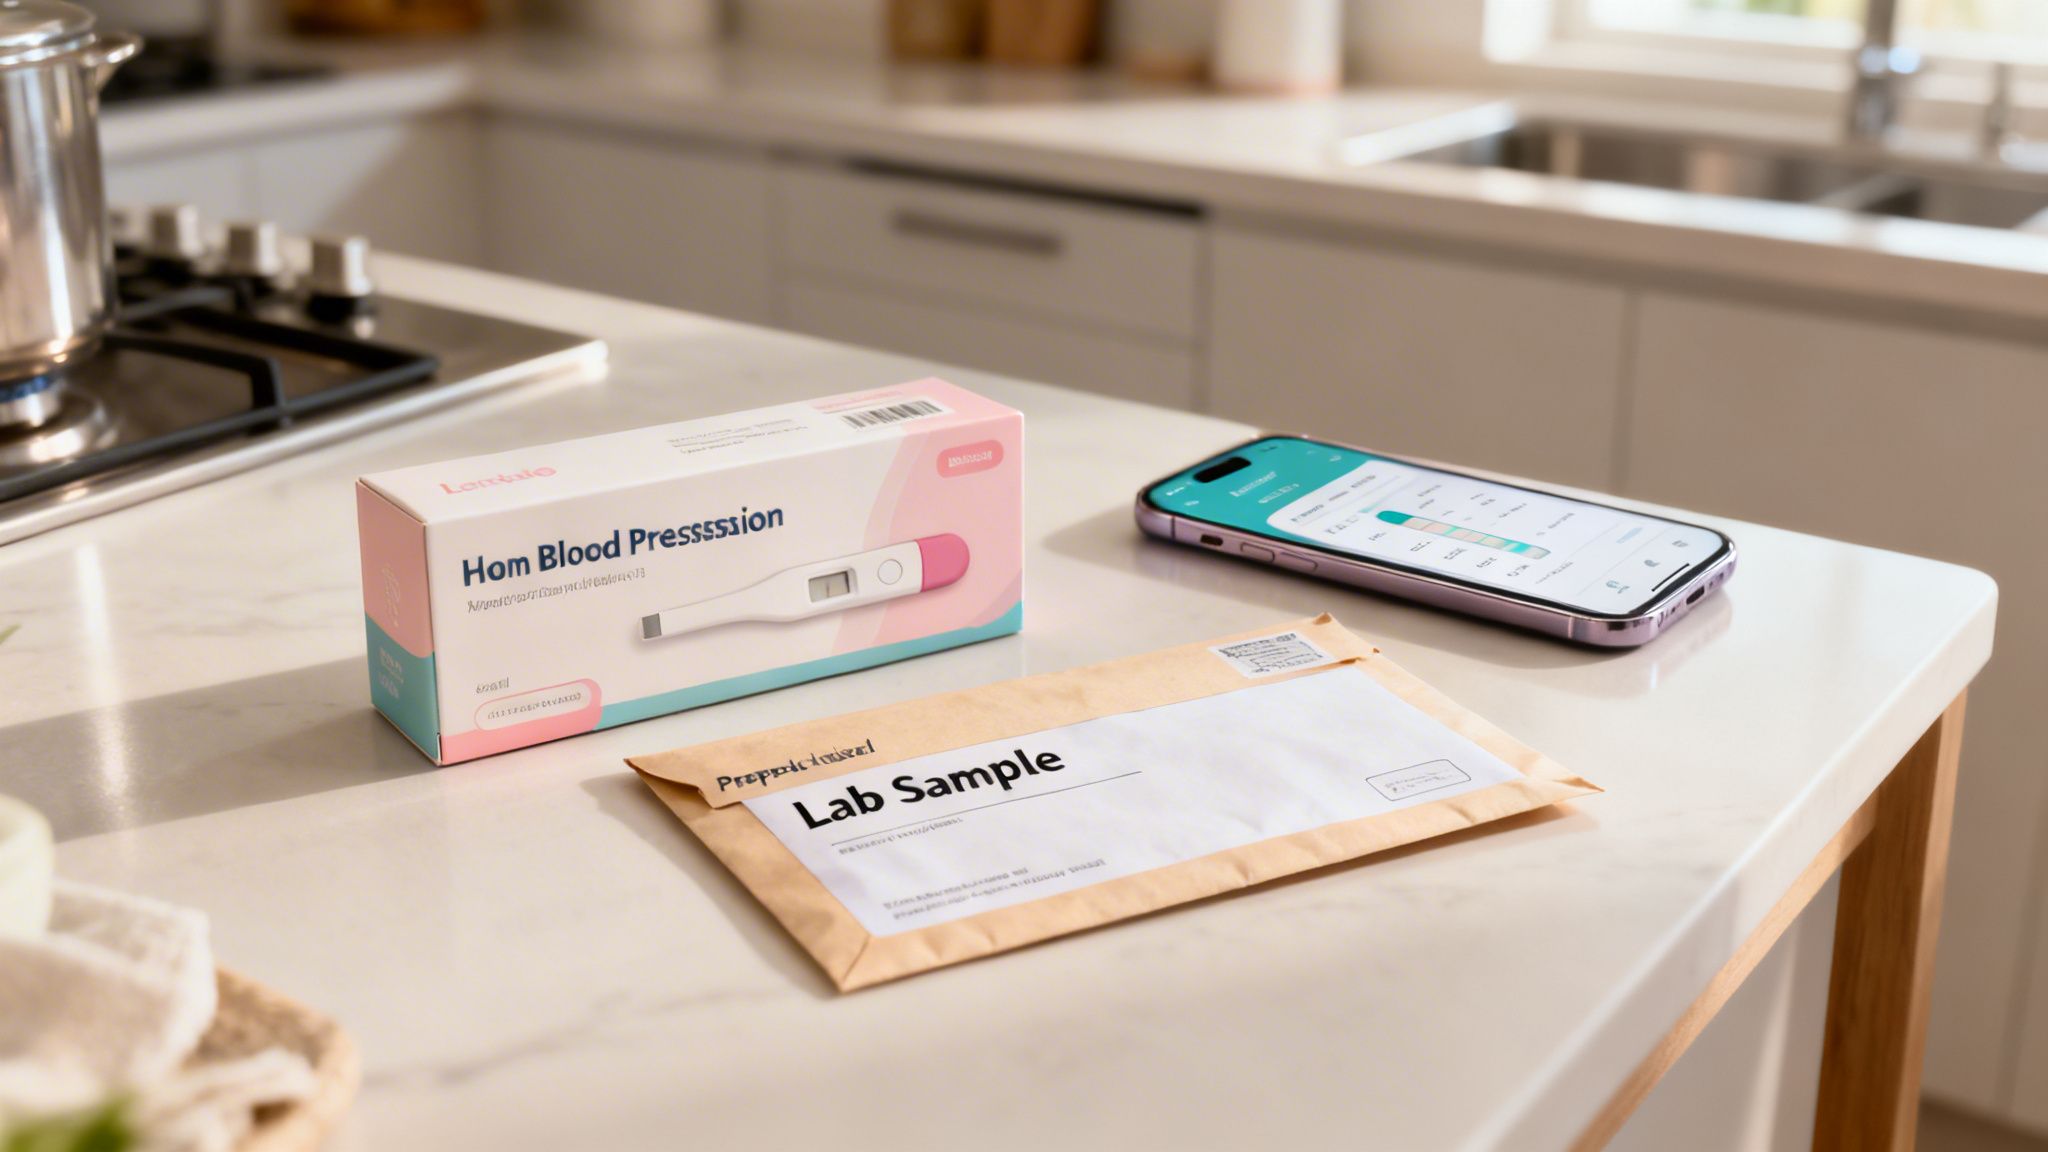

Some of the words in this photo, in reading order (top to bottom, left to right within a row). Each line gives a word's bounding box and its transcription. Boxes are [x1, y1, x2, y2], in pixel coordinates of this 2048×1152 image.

[462, 555, 531, 587] Hom
[538, 529, 621, 572] Blood
[792, 785, 885, 830] Lab
[891, 749, 1066, 804] Sample
